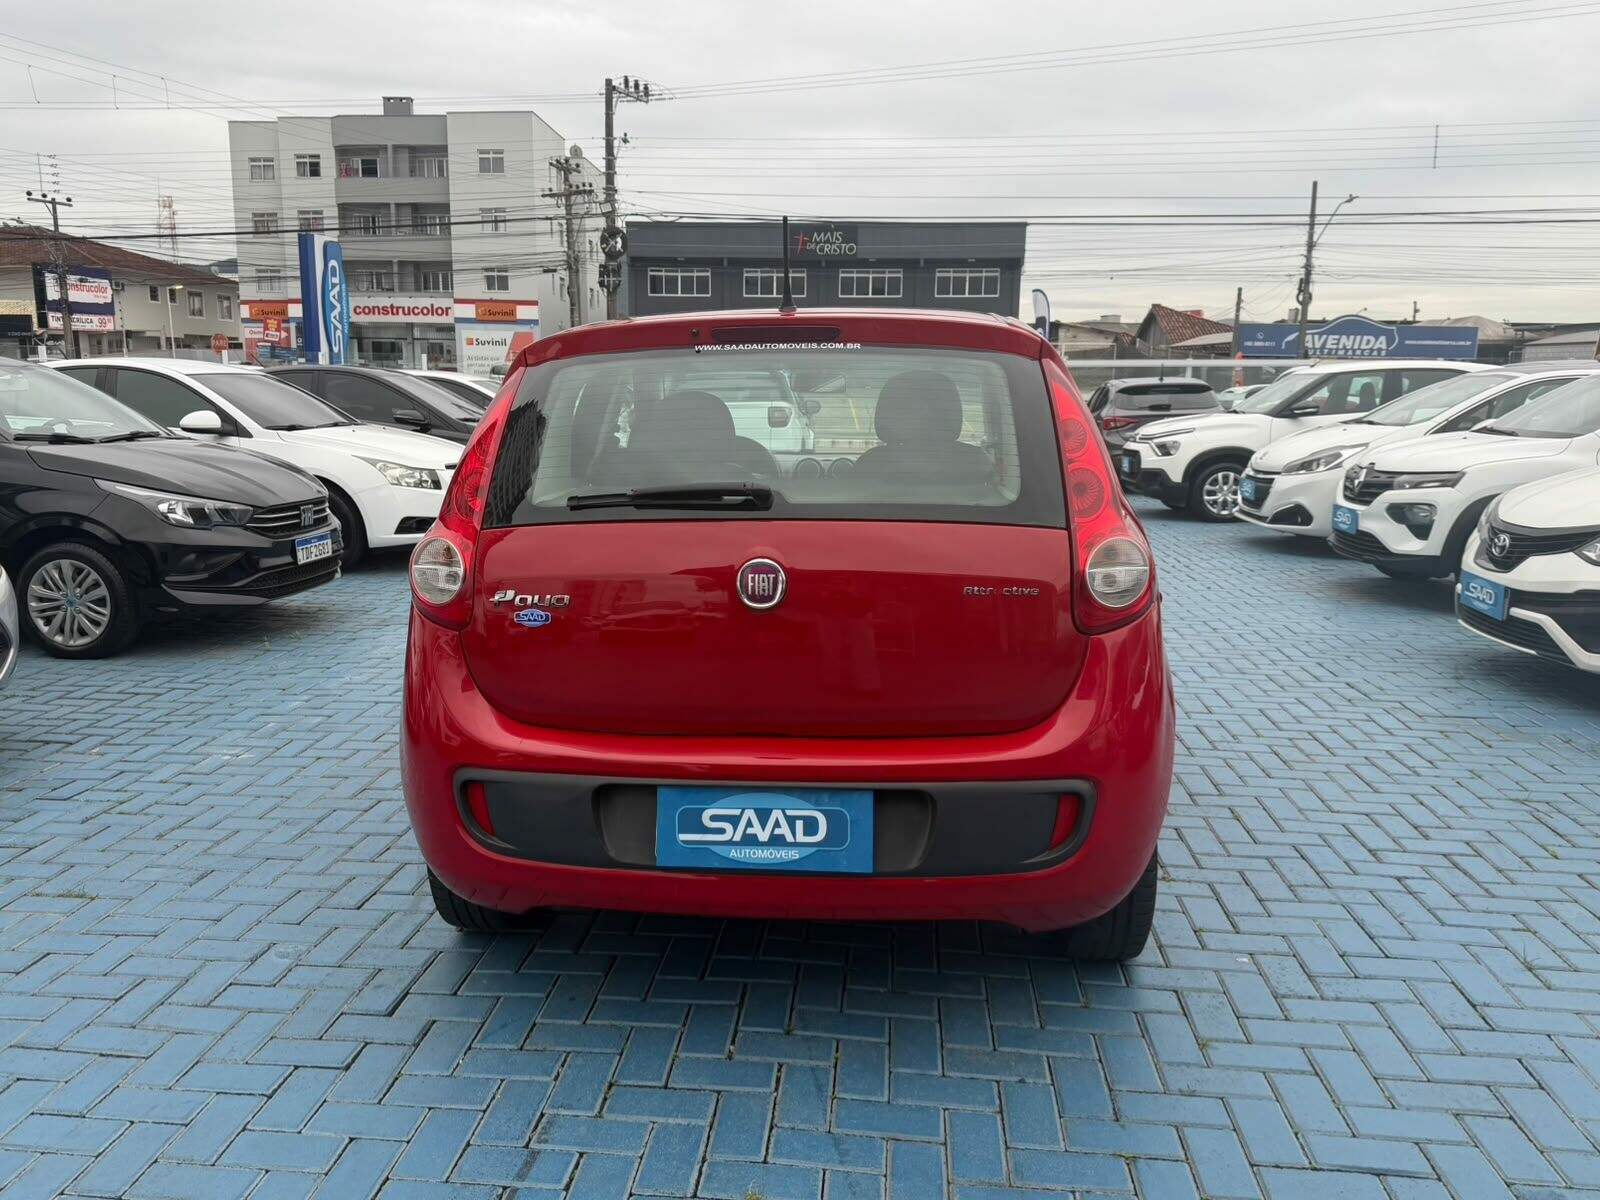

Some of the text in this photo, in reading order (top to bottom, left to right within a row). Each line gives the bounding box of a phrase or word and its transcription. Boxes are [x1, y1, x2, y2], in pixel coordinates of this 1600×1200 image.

[811, 231, 843, 243] MAIS
[816, 243, 857, 256] CRISTO
[261, 308, 286, 316] Suvinil
[328, 259, 345, 365] SAAD
[353, 303, 452, 317] construcolor
[487, 309, 514, 317] Suvinil
[475, 338, 507, 347] Suvinil
[695, 342, 861, 351] WWW.SAADAUTOMOVEIS.COM.BR
[1305, 334, 1388, 350] AVENIDA
[748, 573, 776, 596] FIAT
[519, 612, 546, 621] SAAD
[678, 808, 828, 843] SAAD
[729, 848, 800, 860] AUTOMÓVEIS
